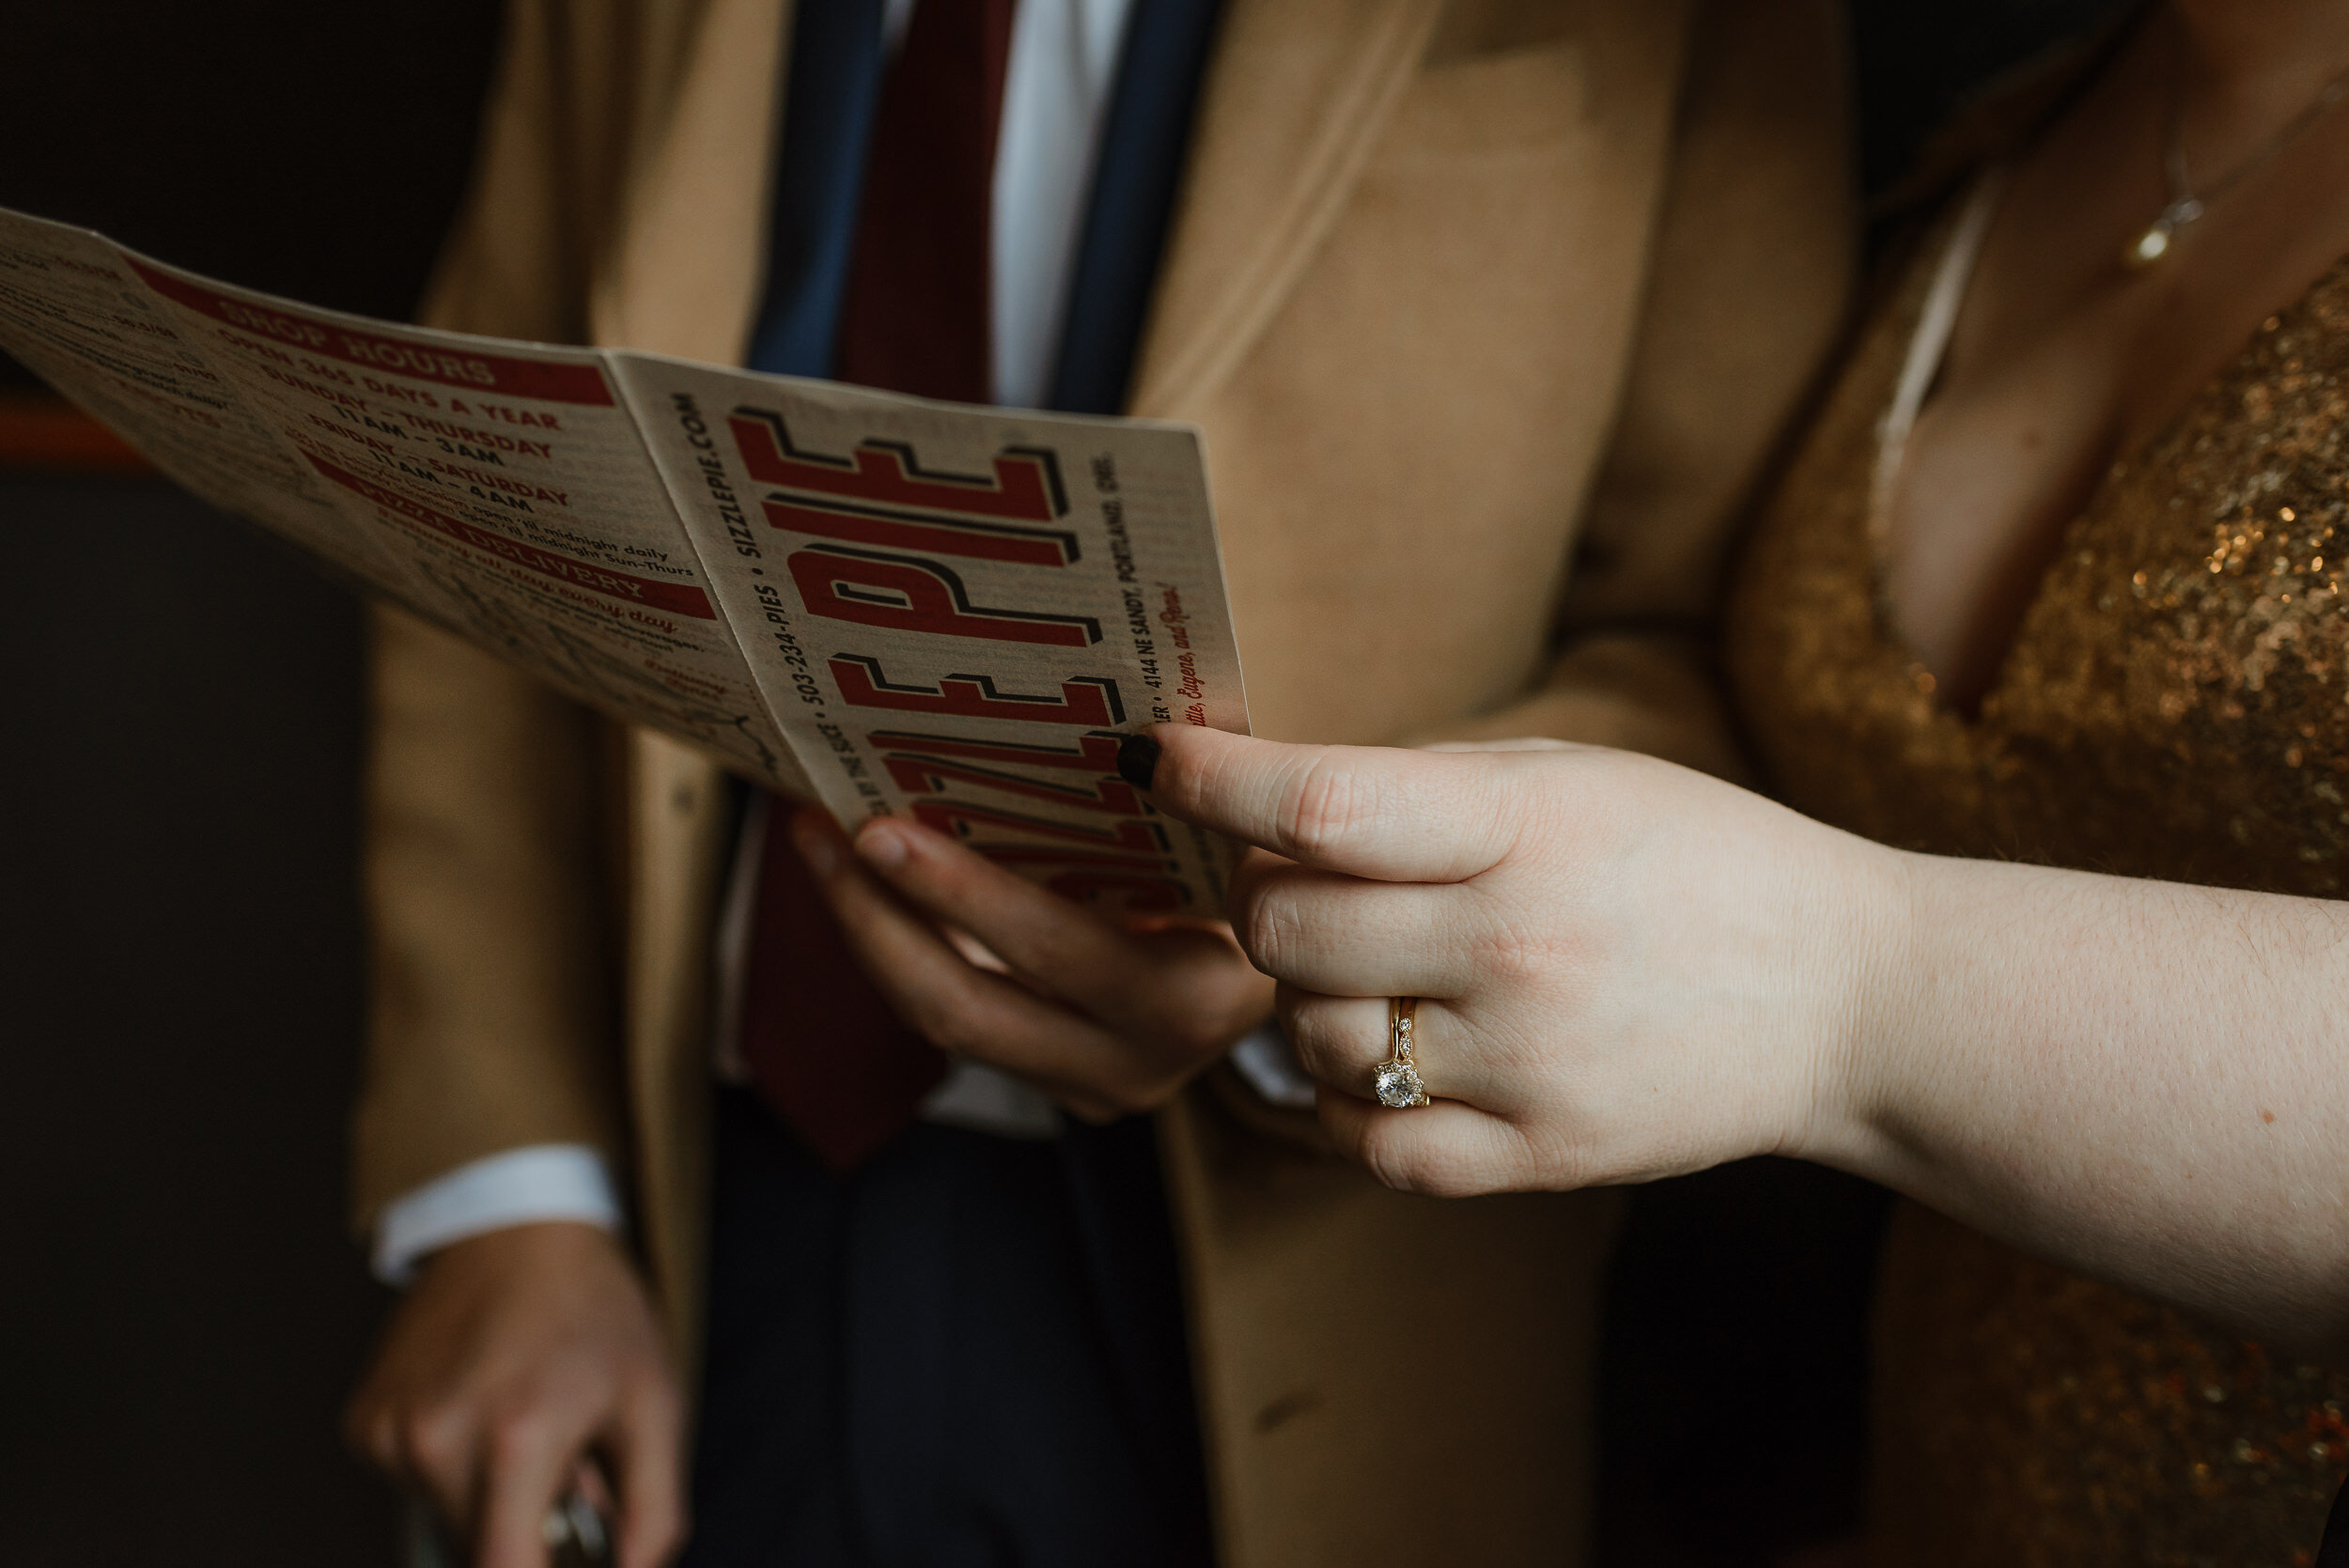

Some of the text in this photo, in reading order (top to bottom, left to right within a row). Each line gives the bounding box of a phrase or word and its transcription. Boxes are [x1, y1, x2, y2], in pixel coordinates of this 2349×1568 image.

[217, 300, 497, 385] SHOP HOURS
[217, 328, 294, 366] OPEN
[300, 357, 356, 386] 365
[363, 376, 440, 409] DAYS
[450, 397, 472, 415] A
[477, 402, 562, 431] YEAR
[260, 364, 368, 412] SUNDAY
[398, 411, 552, 458] THURSDAY
[307, 412, 397, 458] FRIDAY
[428, 458, 568, 507] SATURDAY
[435, 436, 506, 468] 3AM
[670, 392, 763, 560] SIZZLEPIE.COM
[470, 485, 535, 514] 4AM
[354, 482, 463, 539] PIZZA
[467, 530, 646, 599] DELIVERY
[459, 510, 499, 529] open
[527, 531, 600, 561] midnight
[472, 505, 513, 523] open
[543, 525, 618, 553] midnight
[622, 544, 669, 563] daily
[727, 405, 1104, 648] PIE
[509, 568, 554, 593] day
[558, 587, 625, 619] every
[628, 609, 678, 634] day
[1121, 587, 1151, 636] SANDY,
[1155, 581, 1191, 624] Reno!
[753, 582, 825, 706] 503-234-PIES
[1134, 637, 1156, 656] NE
[1164, 624, 1191, 650] and
[1140, 658, 1163, 690] 4144
[1176, 650, 1206, 700] Eugene,
[817, 722, 856, 754] SLICE
[839, 754, 870, 780] THE
